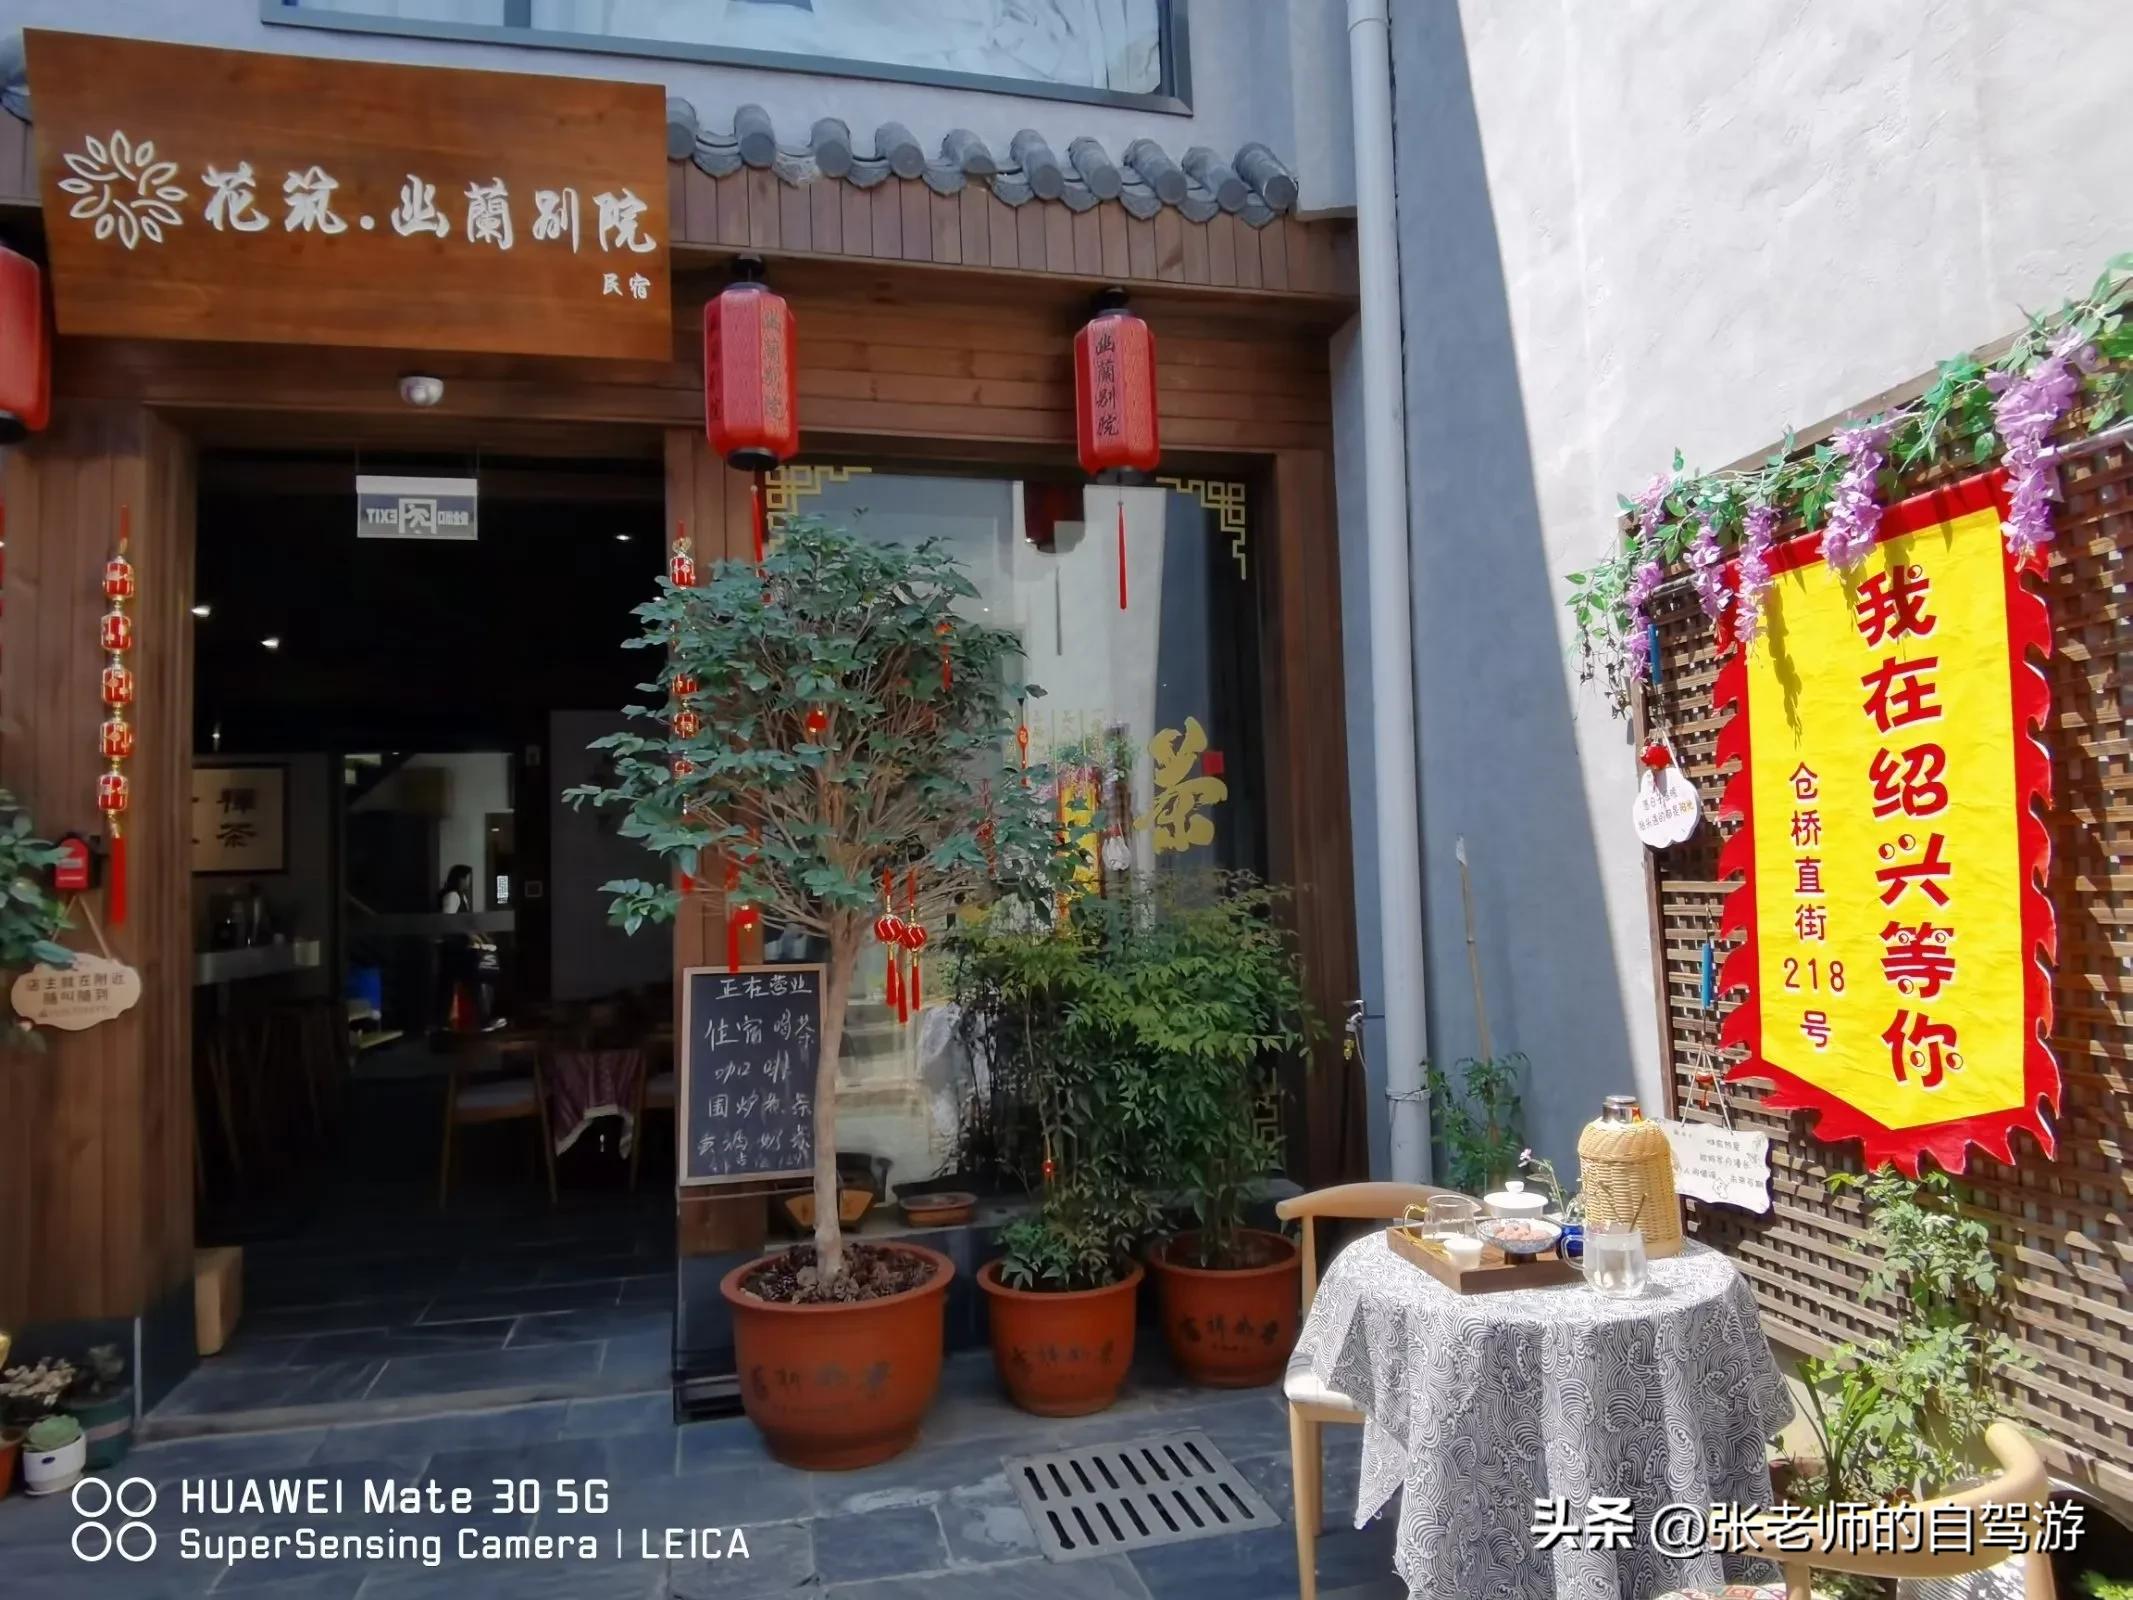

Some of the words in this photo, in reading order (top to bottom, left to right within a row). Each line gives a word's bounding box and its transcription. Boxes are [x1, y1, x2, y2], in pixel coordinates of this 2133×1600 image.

[601, 271, 651, 300] 民宿
[1133, 716, 1228, 854] 茶
[1855, 563, 1964, 1089] 我在绍兴等你
[715, 973, 812, 1000] 正在营业
[714, 1050, 792, 1085] 咖啡
